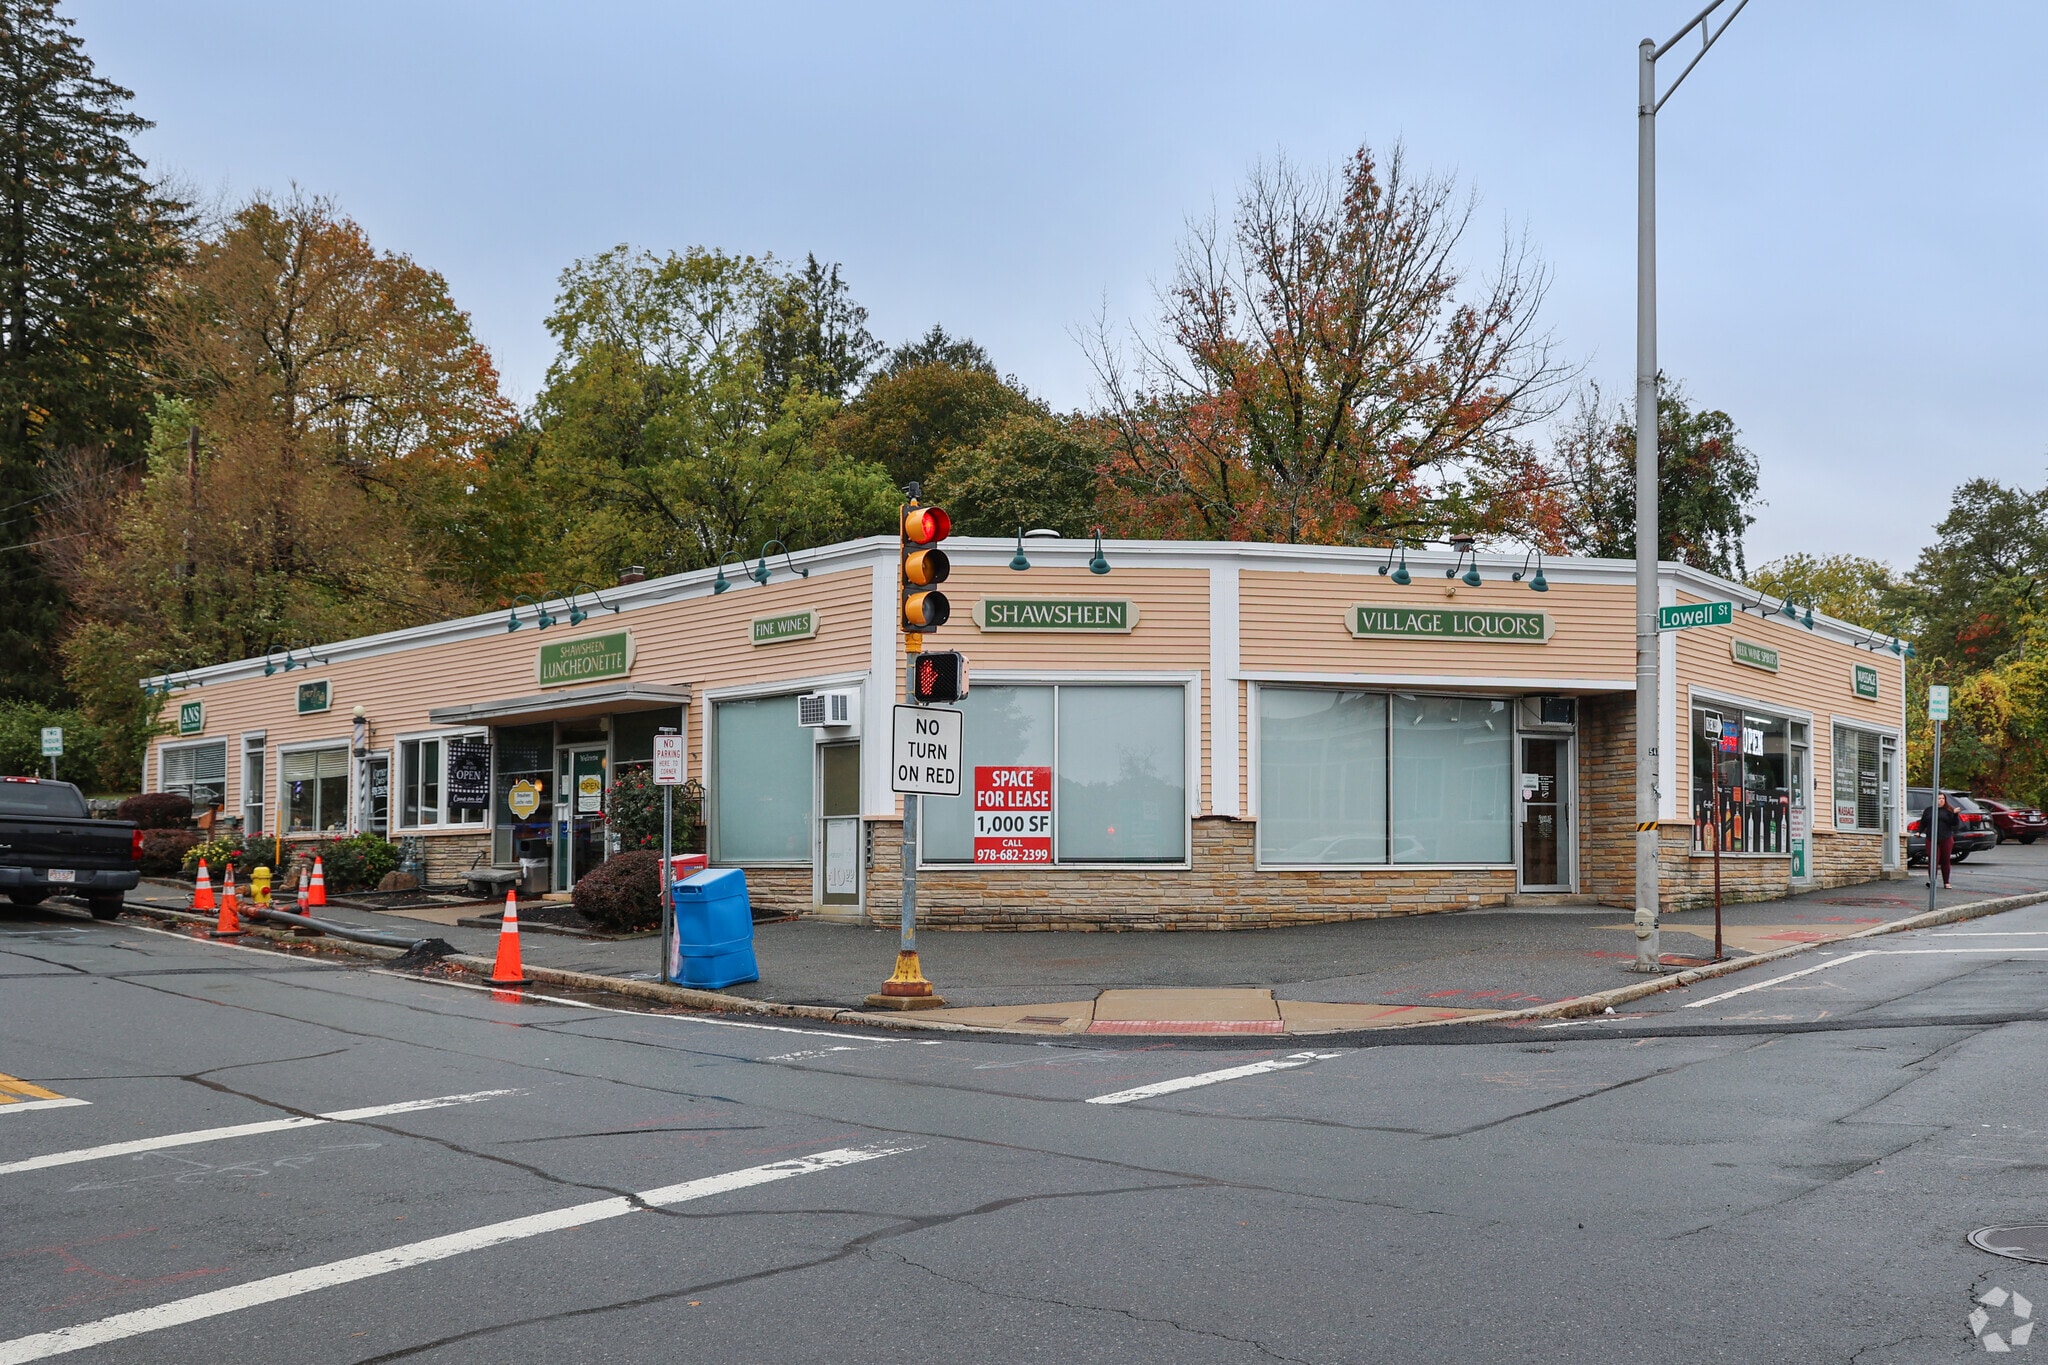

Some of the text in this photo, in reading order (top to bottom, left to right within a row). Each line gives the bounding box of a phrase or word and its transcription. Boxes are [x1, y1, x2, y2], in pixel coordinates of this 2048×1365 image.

[990, 604, 1121, 625] SHAWSHEEN
[1662, 604, 1728, 627] Lowell St
[756, 616, 808, 637] FINE WINES
[1361, 612, 1540, 637] VILLAGE LIQUORS
[560, 640, 605, 658] SHAWSHEEN
[1737, 643, 1777, 665] BEER WINE SPIRITS
[543, 652, 622, 679] LUNCHEONETTE
[1857, 670, 1876, 686] MASSAGE
[182, 706, 200, 723] ANS
[916, 718, 940, 736] NO
[664, 739, 674, 748] NO
[908, 741, 947, 760] TURN
[1743, 727, 1764, 756] OPEN
[657, 750, 681, 758] PARKING
[456, 770, 481, 780] OPEN
[898, 765, 955, 784] ON RED
[992, 770, 1034, 787] SPACE
[580, 782, 600, 790] OPEN
[453, 794, 467, 802] Come
[977, 790, 1049, 807] FOR LEASE
[977, 815, 1049, 834] 1,000 SF
[1002, 839, 1023, 847] CALL
[977, 849, 1048, 861] 978-682-2399
